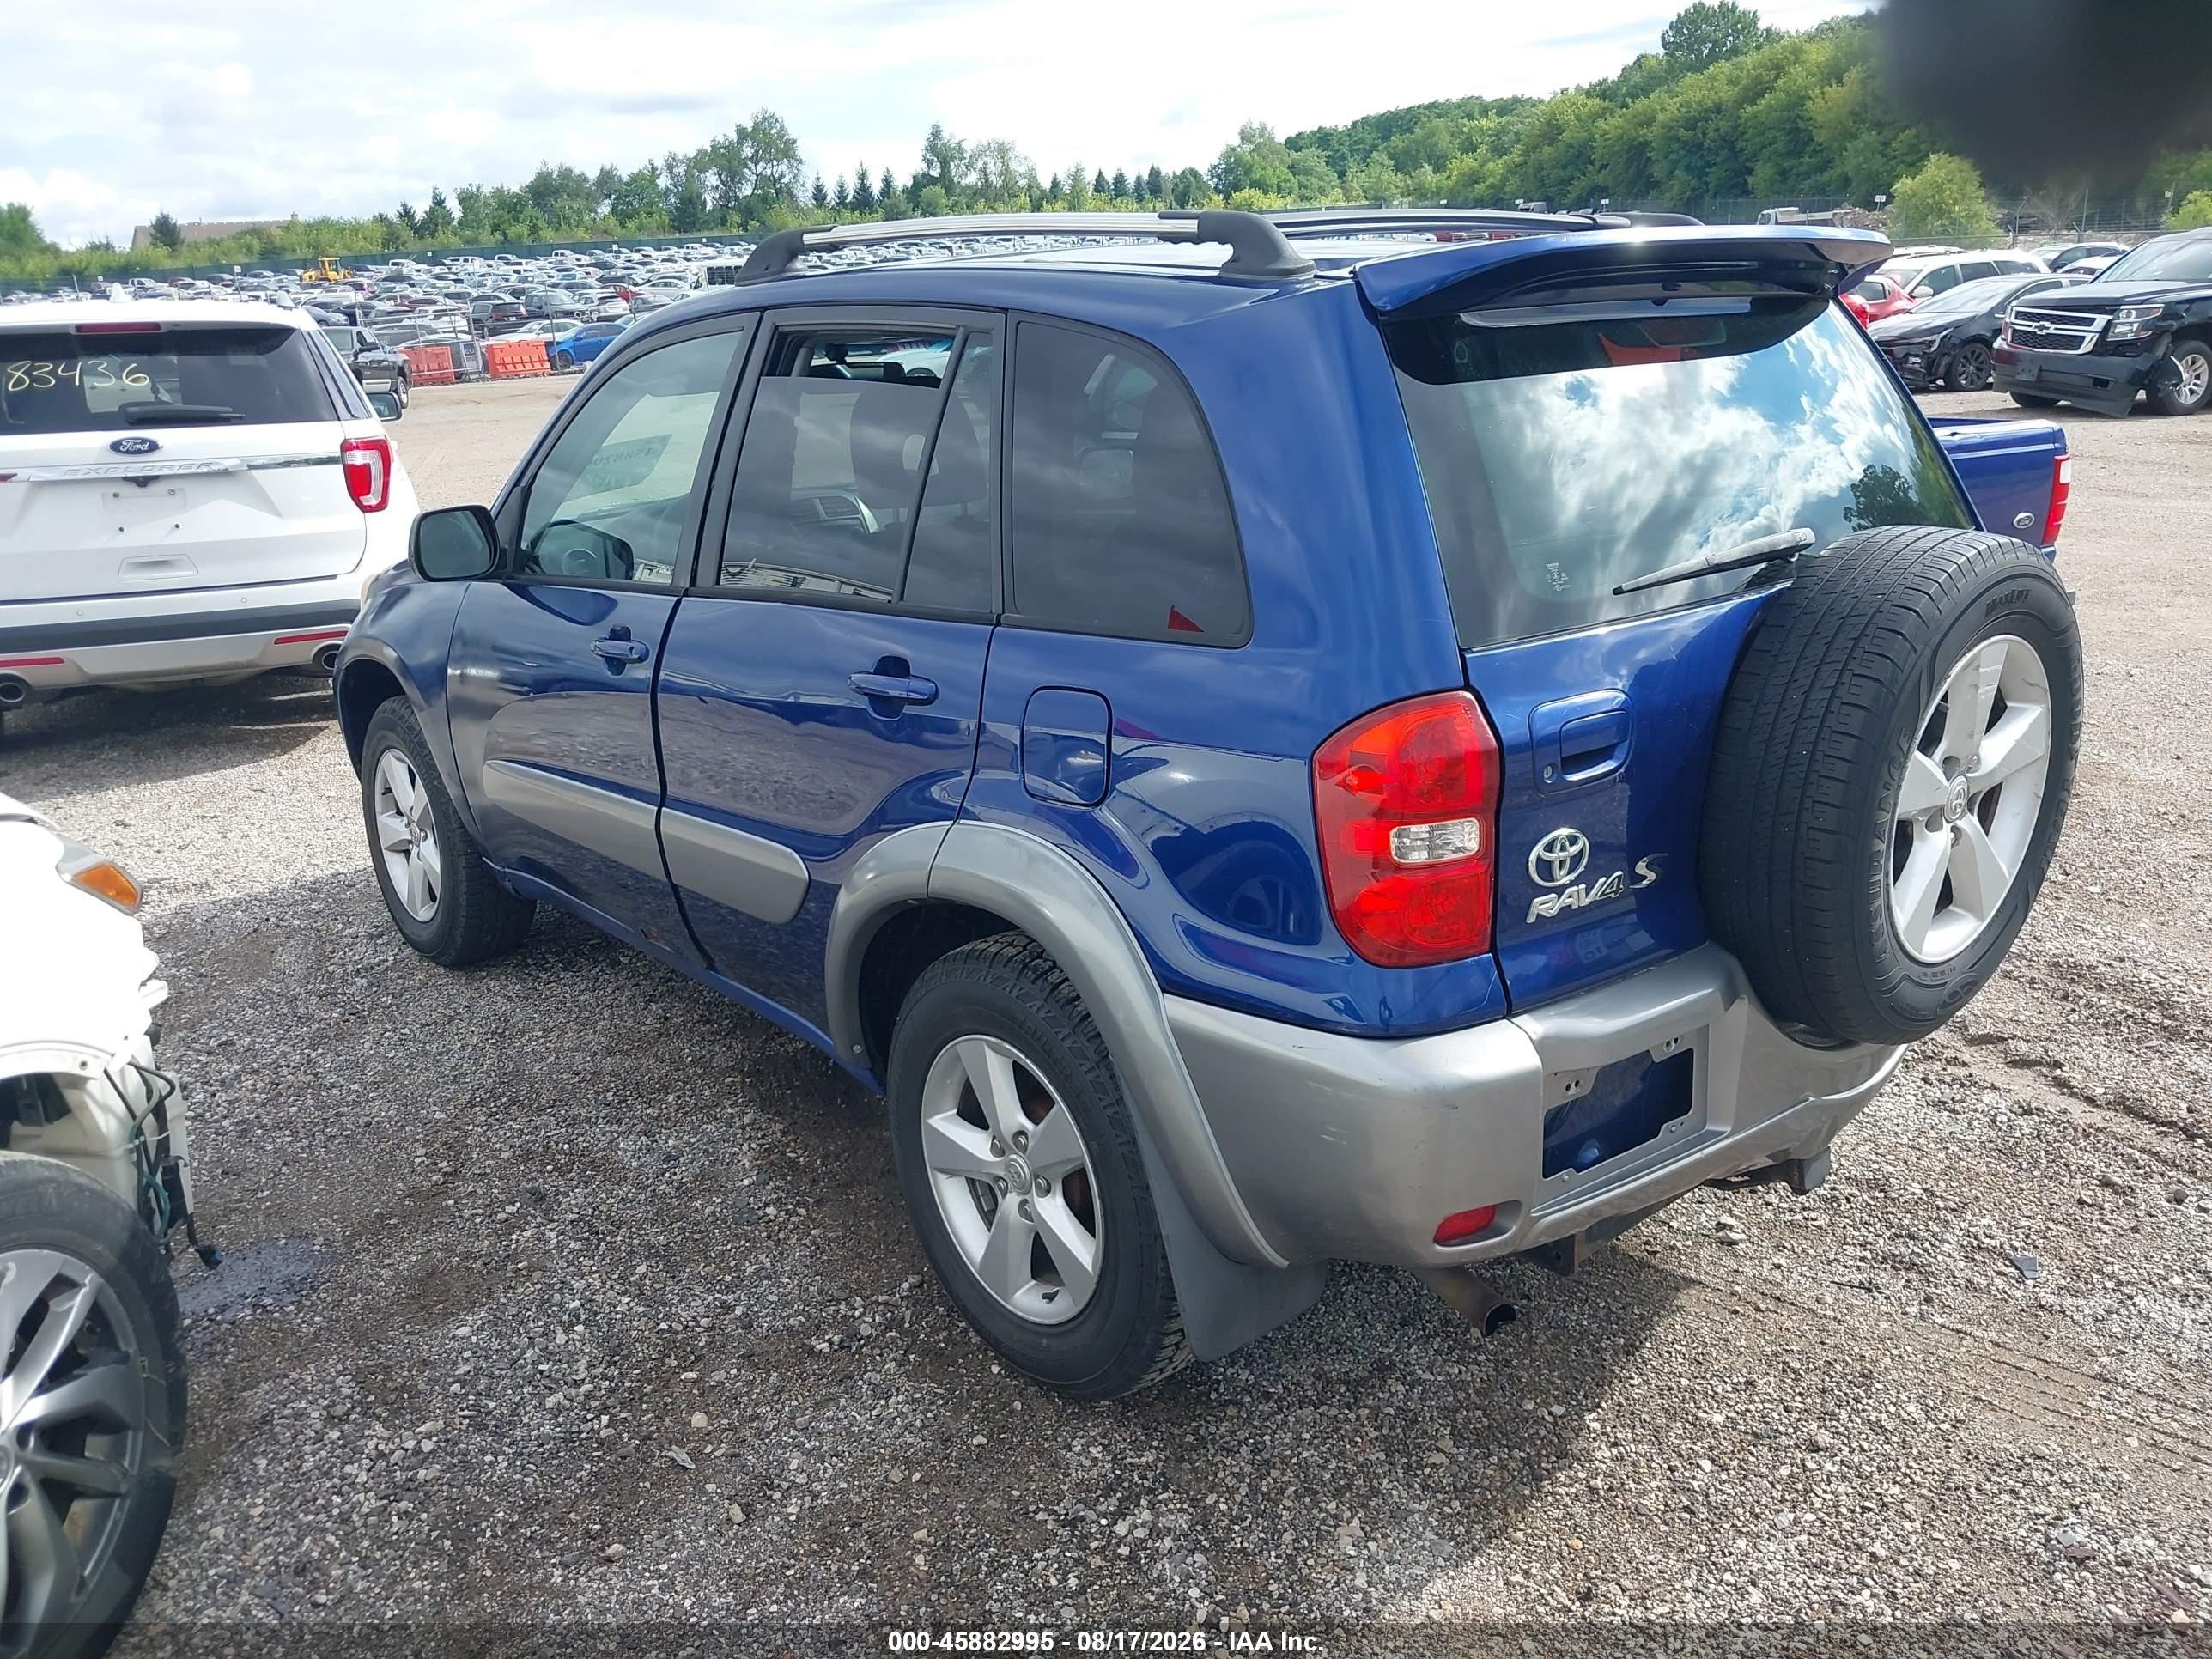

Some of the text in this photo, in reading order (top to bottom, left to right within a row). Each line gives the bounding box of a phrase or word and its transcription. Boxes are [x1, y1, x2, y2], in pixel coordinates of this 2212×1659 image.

[6, 360, 150, 392] 83436
[119, 438, 150, 452] Ford
[1526, 870, 1625, 924] RAV4
